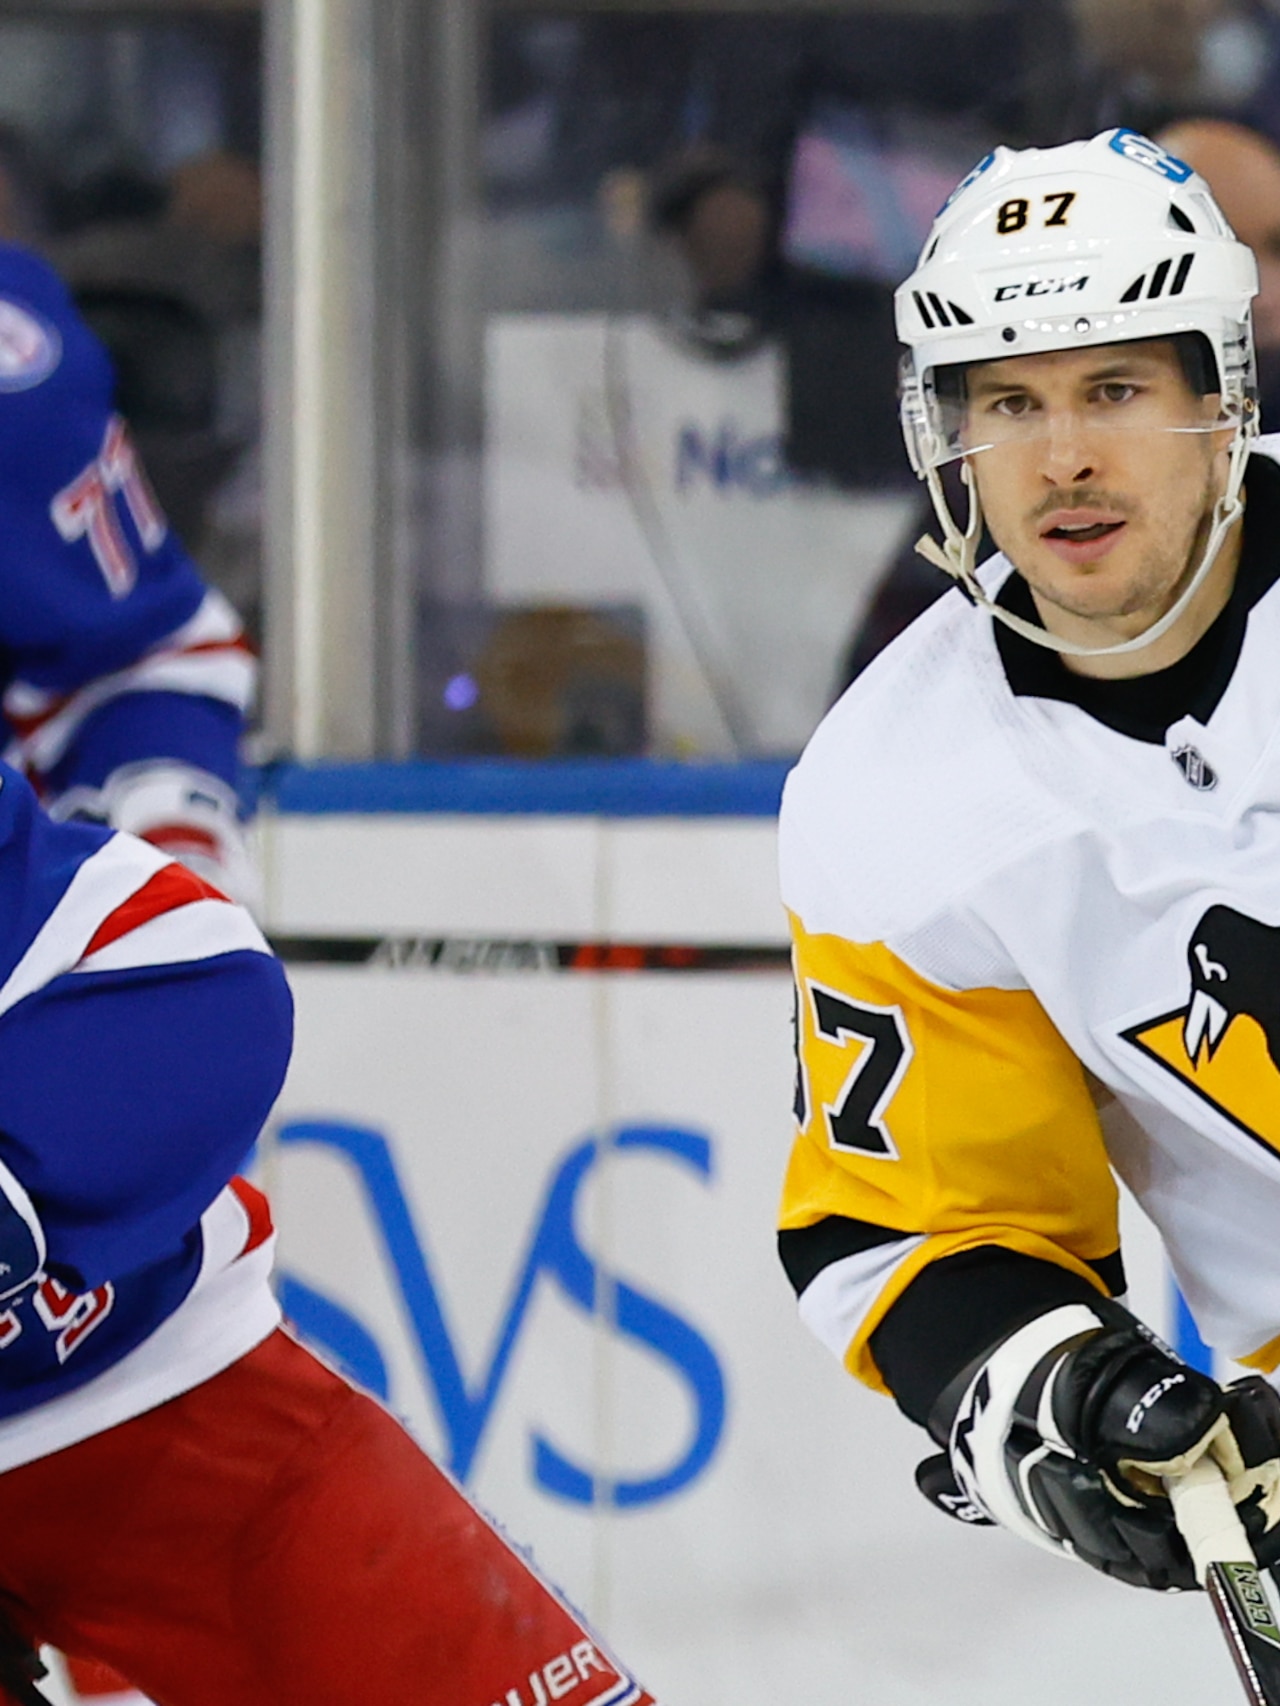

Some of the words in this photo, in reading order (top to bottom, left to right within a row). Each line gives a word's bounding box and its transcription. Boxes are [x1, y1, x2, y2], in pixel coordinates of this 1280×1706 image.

[996, 190, 1077, 235] 87
[993, 275, 1091, 302] CCM
[792, 975, 916, 1162] 7
[1125, 1373, 1186, 1434] CCM
[1230, 1566, 1274, 1627] CCM
[490, 1639, 618, 1706] UER
